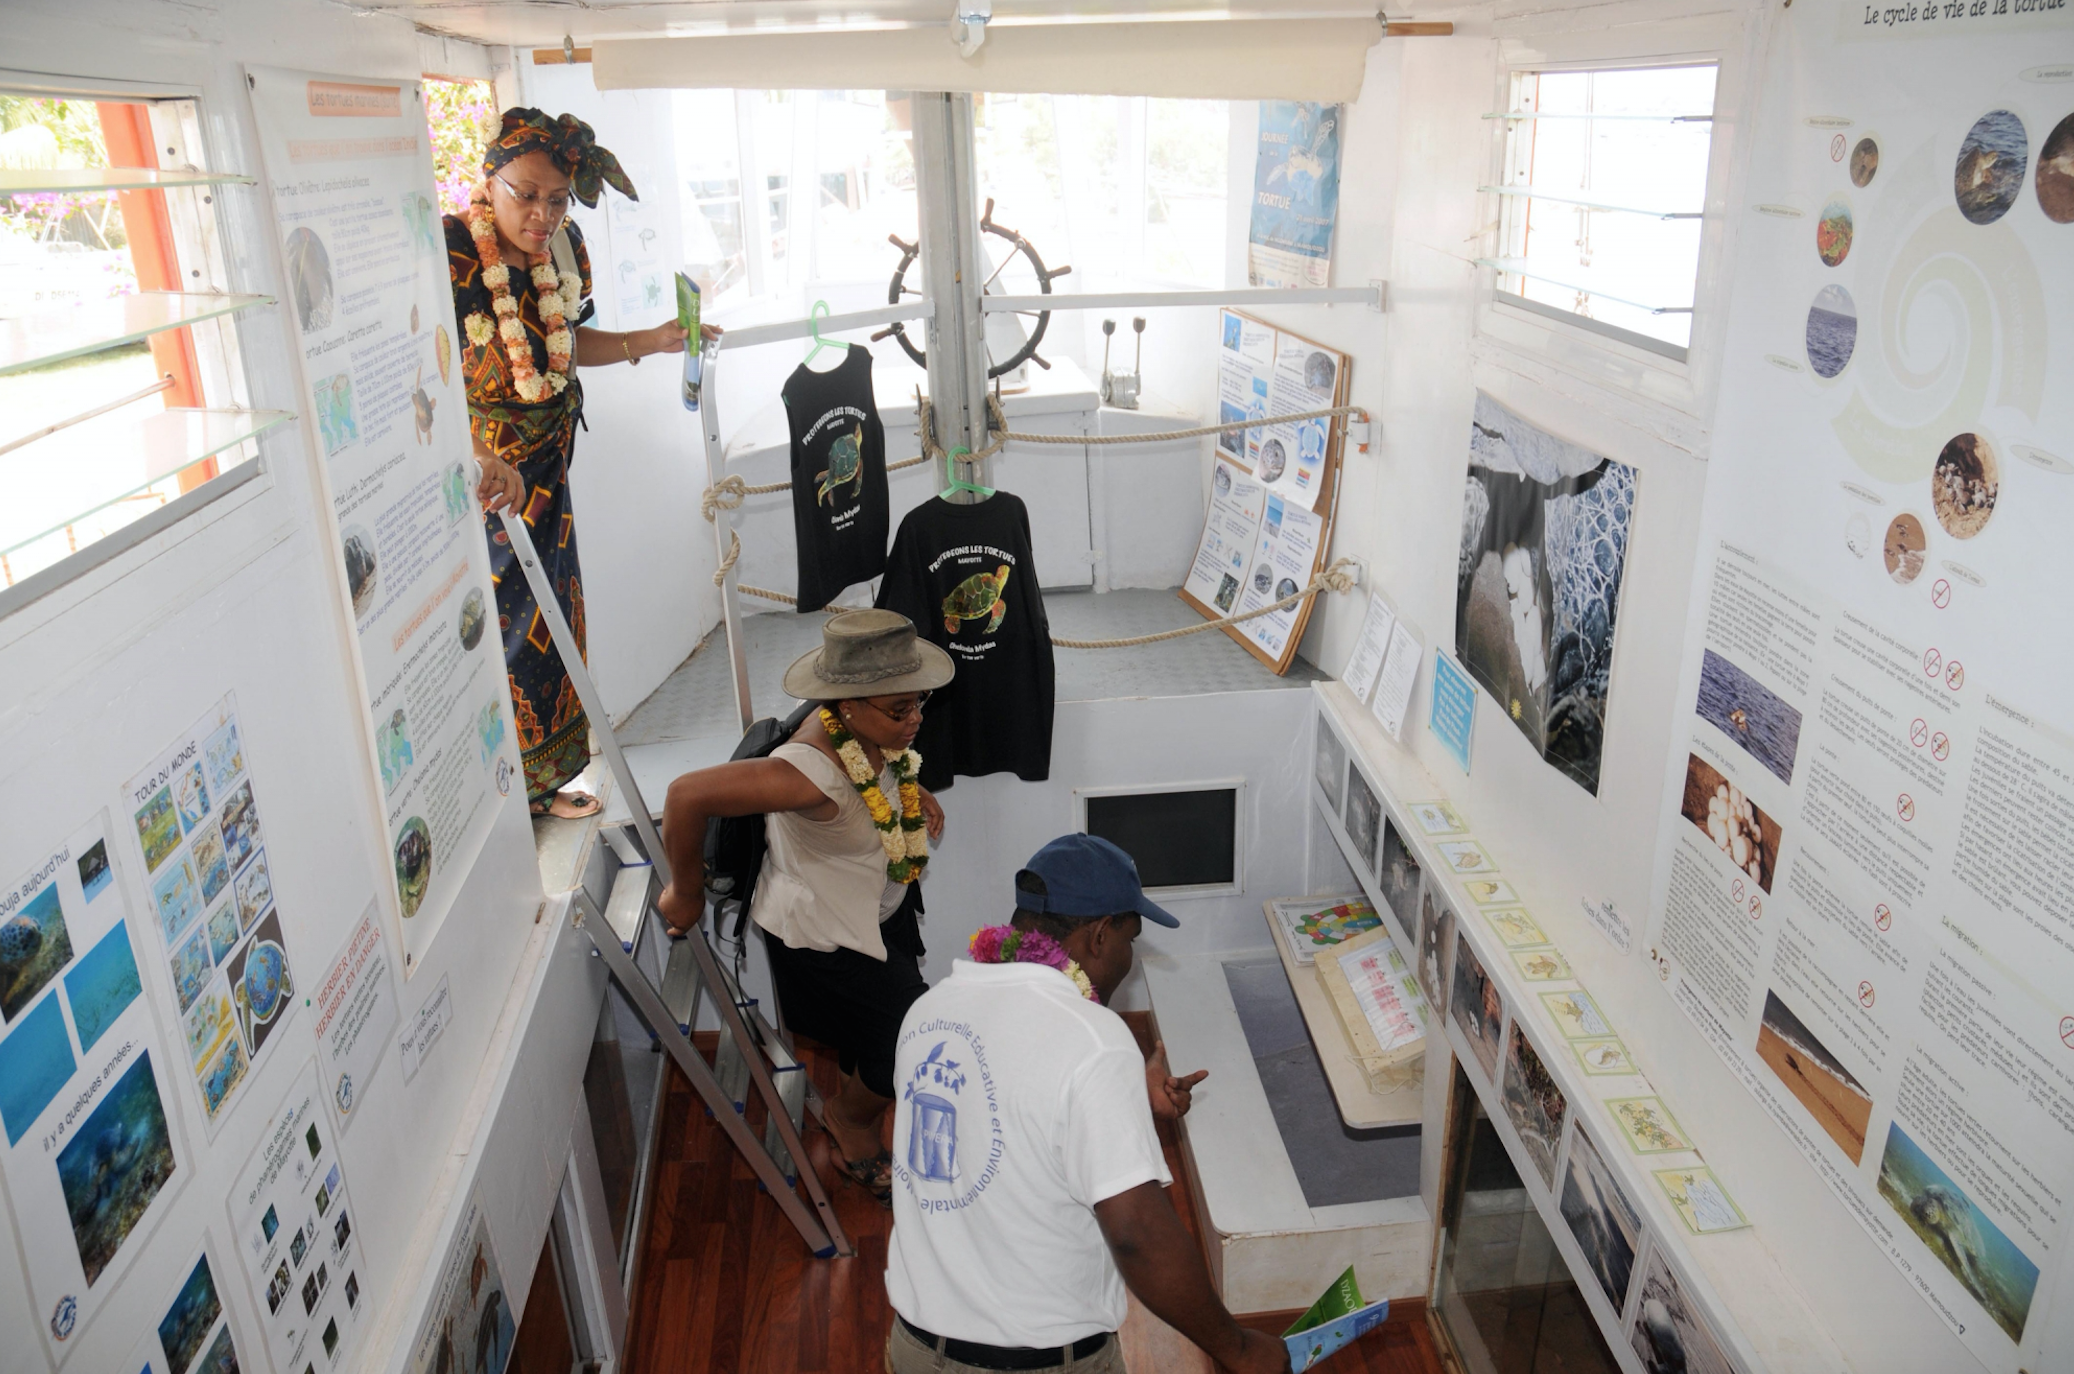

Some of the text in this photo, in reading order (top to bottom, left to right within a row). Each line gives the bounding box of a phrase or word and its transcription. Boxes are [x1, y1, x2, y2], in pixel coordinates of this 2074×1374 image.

[1864, 0, 2065, 27] Le cycle de vie de la tortue
[311, 92, 324, 106] Les
[326, 94, 354, 108] tortues
[1261, 131, 1290, 144] JOURNÉE
[1258, 191, 1290, 210] TORTUE
[1315, 216, 1329, 226] 2007
[305, 343, 321, 360] ortue
[333, 489, 345, 508] rtue
[970, 545, 982, 554] LES
[984, 546, 1016, 566] TORTUES
[974, 641, 996, 652] Mydas
[1842, 609, 1868, 630] Creusement
[1880, 632, 1894, 646] cavité
[1895, 640, 1918, 661] corporelle
[1830, 672, 1893, 721] Creusement du puits de ponte
[1985, 692, 2030, 726] L'émergence
[1824, 746, 1837, 762] ponte
[1976, 733, 2039, 777] composition du sable.
[1978, 723, 2070, 783] L'incubation dure entre 45 et
[134, 739, 197, 806] TOUR DU MONDE
[388, 803, 401, 827] ortue
[22, 844, 71, 897] aujourd'hui
[1953, 857, 2051, 938] Les juvéniles sur la plage sont les proies
[1958, 872, 1967, 885] des
[1967, 879, 1983, 897] chiens
[1983, 891, 2003, 913] errants.
[1941, 914, 1978, 952] La migration
[317, 918, 370, 1008] HERBIER PIETINE
[1939, 947, 1992, 997] La migration passive
[315, 926, 380, 1039] HERBIER EN DANGER
[919, 1018, 974, 1041] Culturelle
[1929, 959, 1939, 974] Une
[1939, 968, 1949, 982] fois
[1954, 980, 1966, 997] l'eau
[1967, 992, 1975, 1005] les
[1976, 999, 2001, 1027] juvéniles
[2002, 1022, 2016, 1039] vont
[2016, 1034, 2054, 1071] directement
[2055, 1066, 2064, 1080] au
[400, 1026, 417, 1057] Pouvz
[970, 1036, 1000, 1112] Educative
[1916, 1043, 1965, 1094] La migration active
[40, 1030, 138, 1152] il y a quelques années...
[990, 1117, 1004, 1134] et
[262, 1141, 274, 1161] Les
[268, 1134, 298, 1185] de Mayotte
